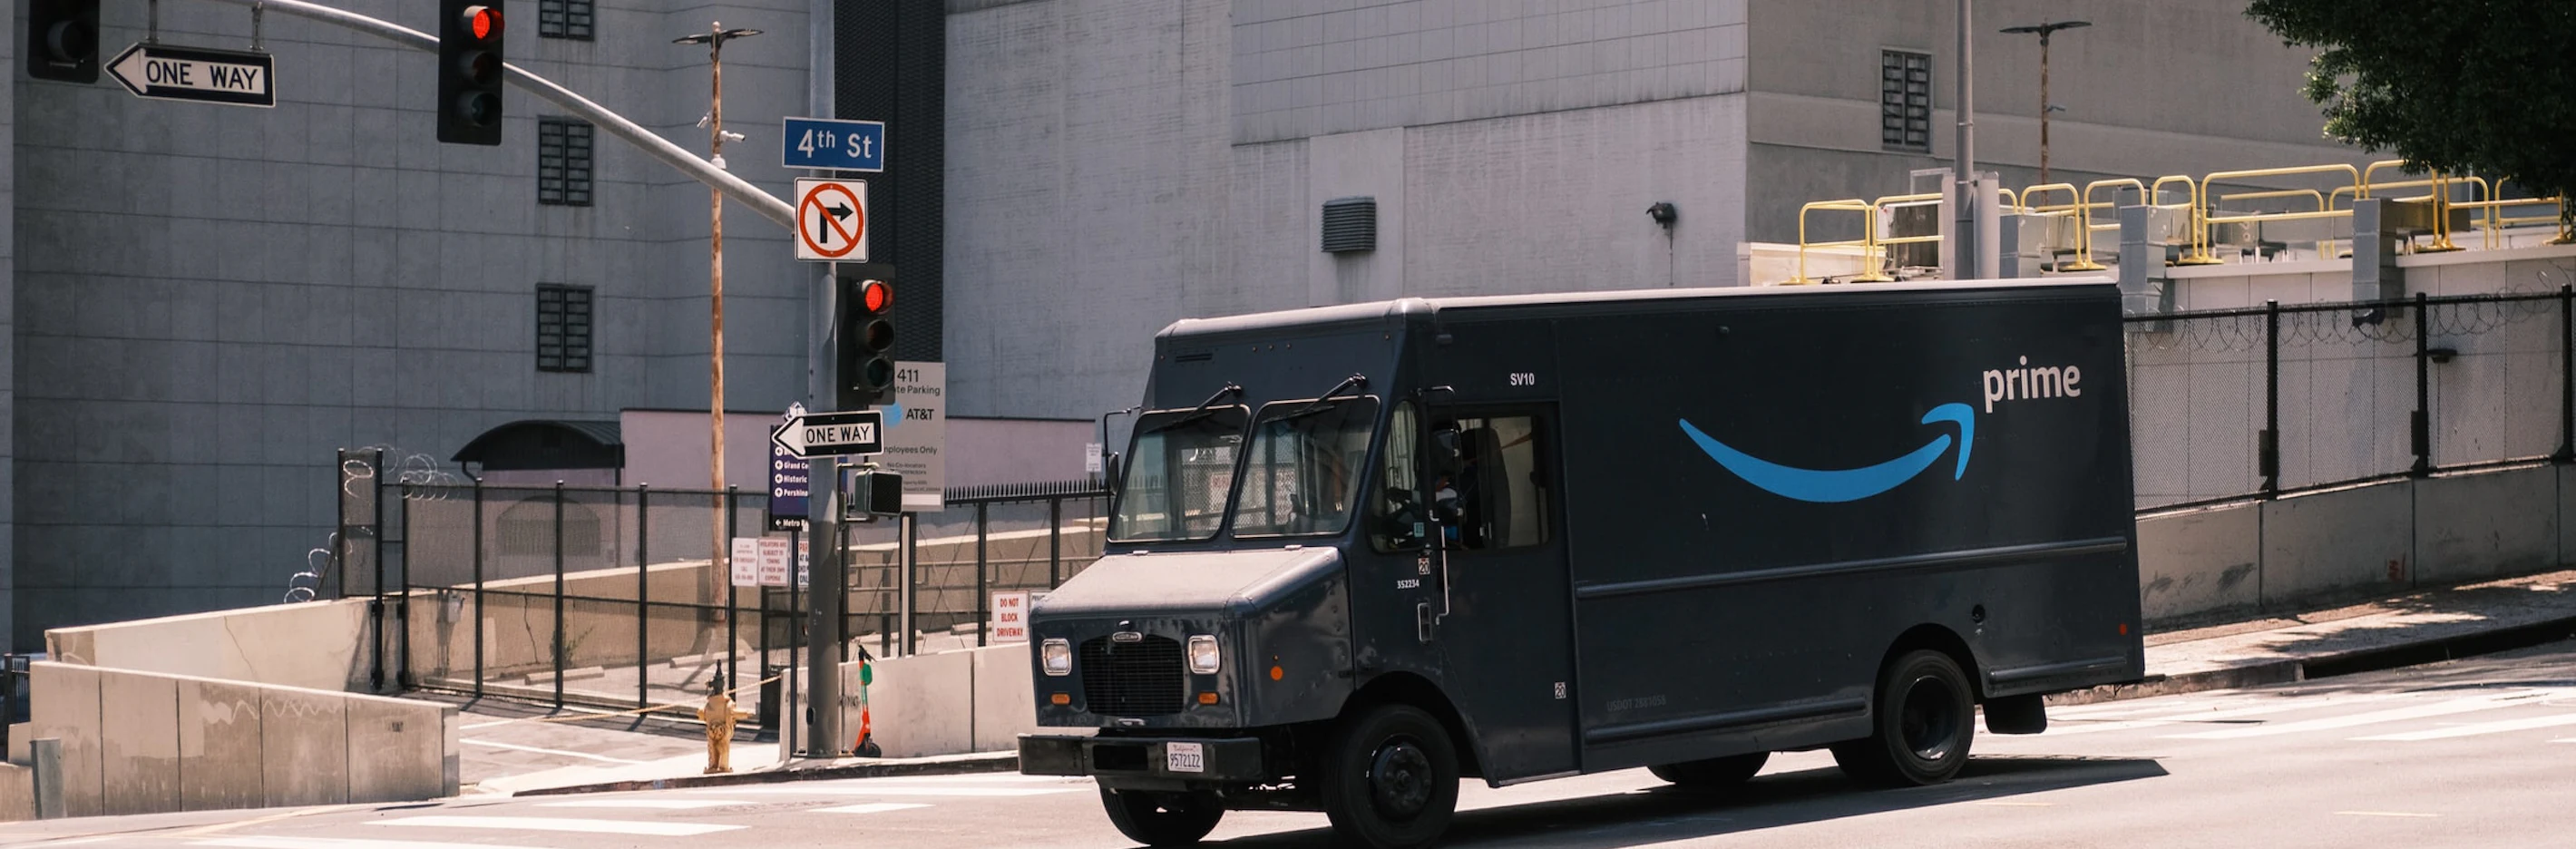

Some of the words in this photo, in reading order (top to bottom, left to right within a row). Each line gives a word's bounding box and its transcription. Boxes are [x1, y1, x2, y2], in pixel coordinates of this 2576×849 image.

[146, 60, 193, 86] ONE
[210, 64, 258, 90] WAY
[797, 129, 835, 159] 4th
[846, 133, 873, 159] St
[897, 369, 919, 382] 411
[1510, 373, 1535, 385] SV10
[1983, 355, 2081, 414] prime
[907, 385, 941, 396] Parking
[906, 408, 934, 420] AT&T
[805, 427, 835, 443] ONE
[840, 425, 870, 442] WAY
[884, 445, 918, 454] mployees
[920, 446, 938, 455] Only
[784, 475, 807, 483] Historic
[1420, 562, 1429, 573] 20
[1000, 598, 1007, 608] DO
[1009, 598, 1019, 607] NOT
[1000, 613, 1019, 622] BLOCK
[997, 628, 1023, 637] DRIVEWAY
